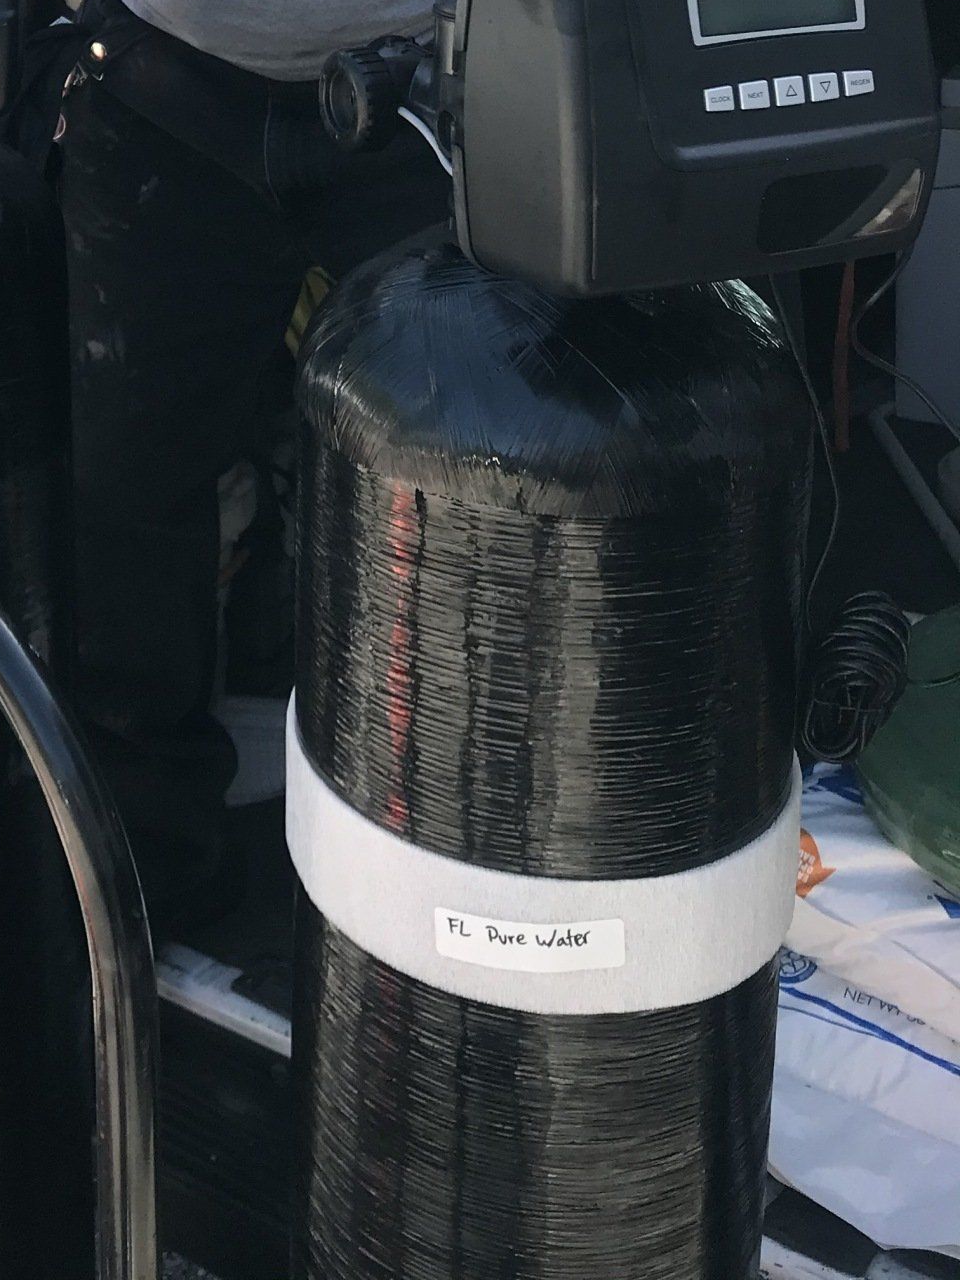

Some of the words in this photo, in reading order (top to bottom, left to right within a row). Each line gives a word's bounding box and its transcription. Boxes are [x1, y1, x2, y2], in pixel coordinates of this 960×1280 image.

[850, 78, 871, 86] REGEN
[748, 91, 764, 99] NEXT
[710, 96, 731, 104] CLOCK
[447, 917, 471, 937] FL
[486, 925, 528, 945] Pure
[536, 929, 590, 948] Water
[844, 987, 874, 1007] NET
